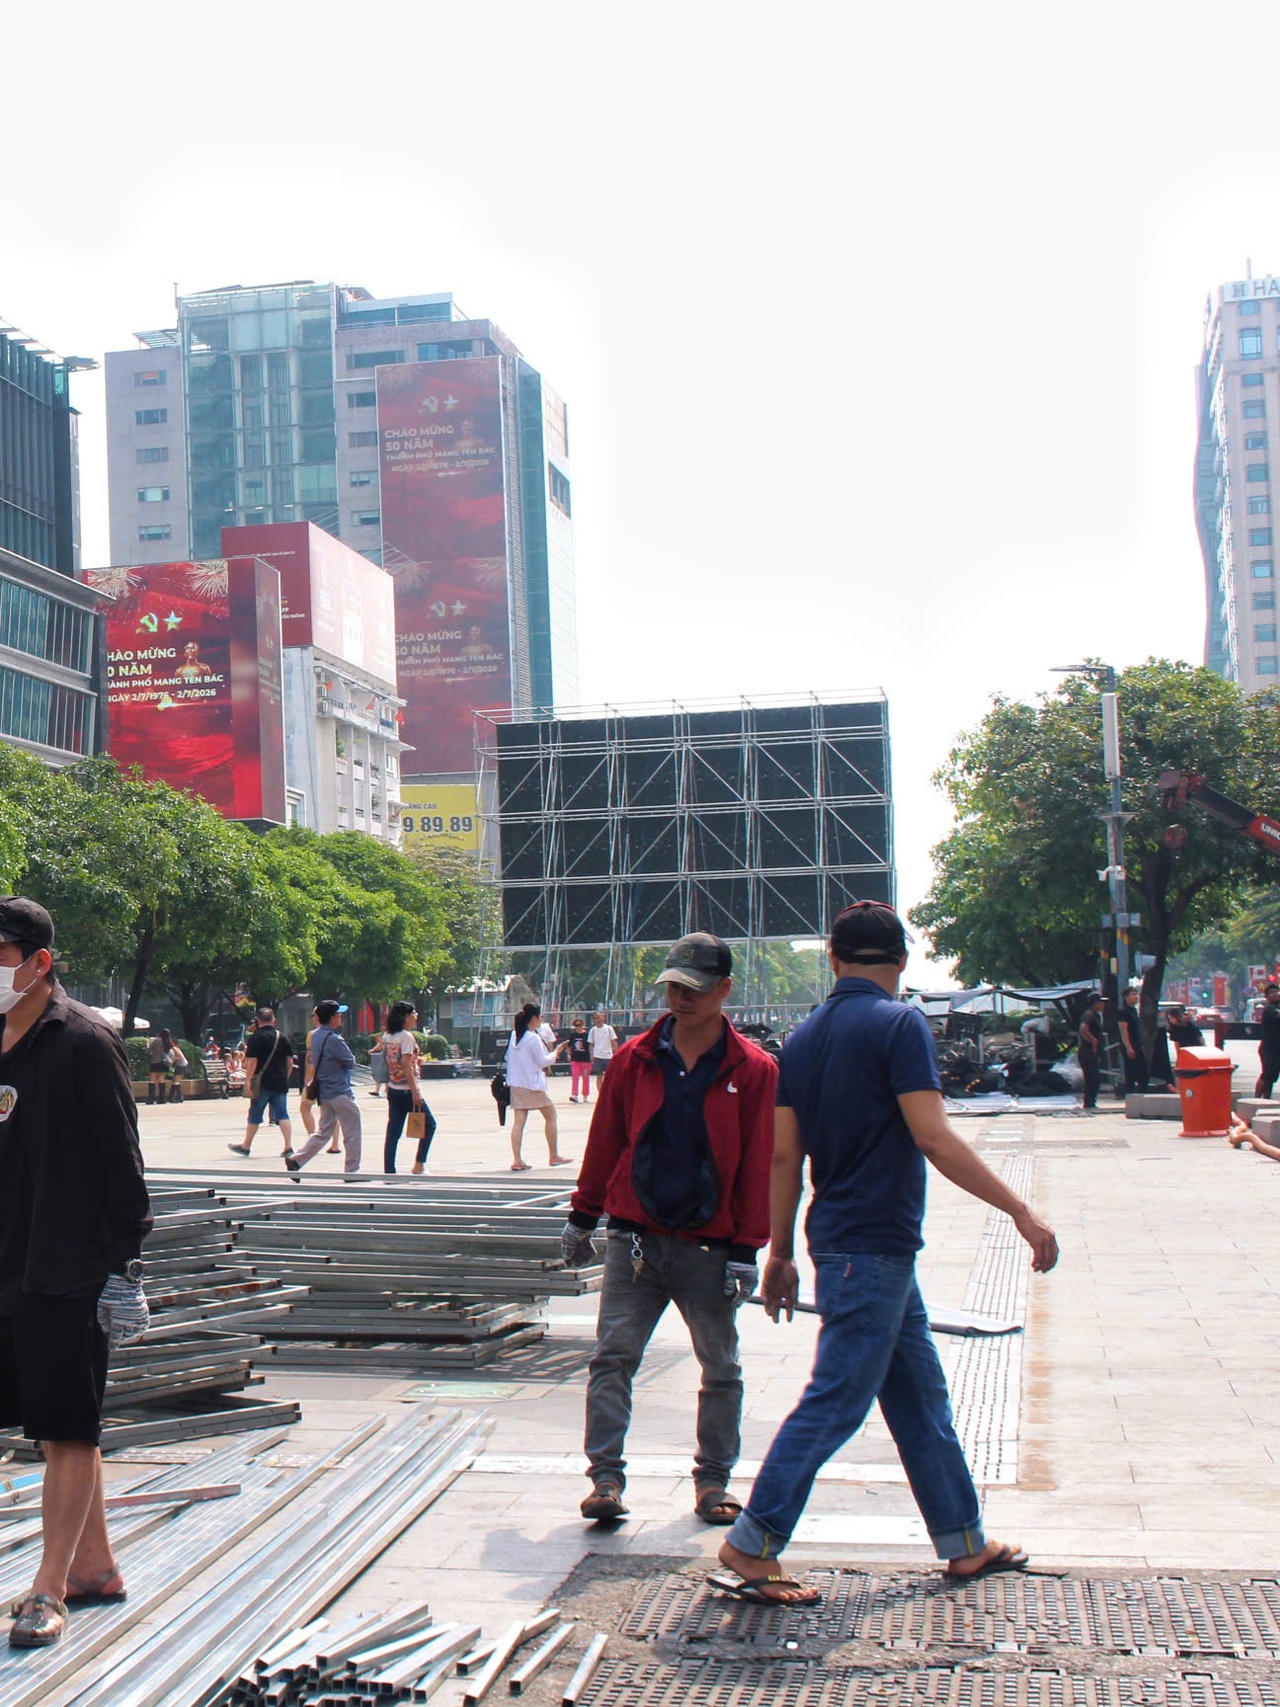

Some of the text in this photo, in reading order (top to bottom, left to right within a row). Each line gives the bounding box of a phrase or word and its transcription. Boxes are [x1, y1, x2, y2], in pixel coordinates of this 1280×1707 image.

[107, 646, 176, 662] HÀO MỪNG
[119, 662, 152, 676] NĂM
[132, 676, 152, 687] PHỐ
[154, 677, 182, 686] MANG
[204, 673, 224, 684] BÁC
[177, 687, 217, 698] 2/7/2026
